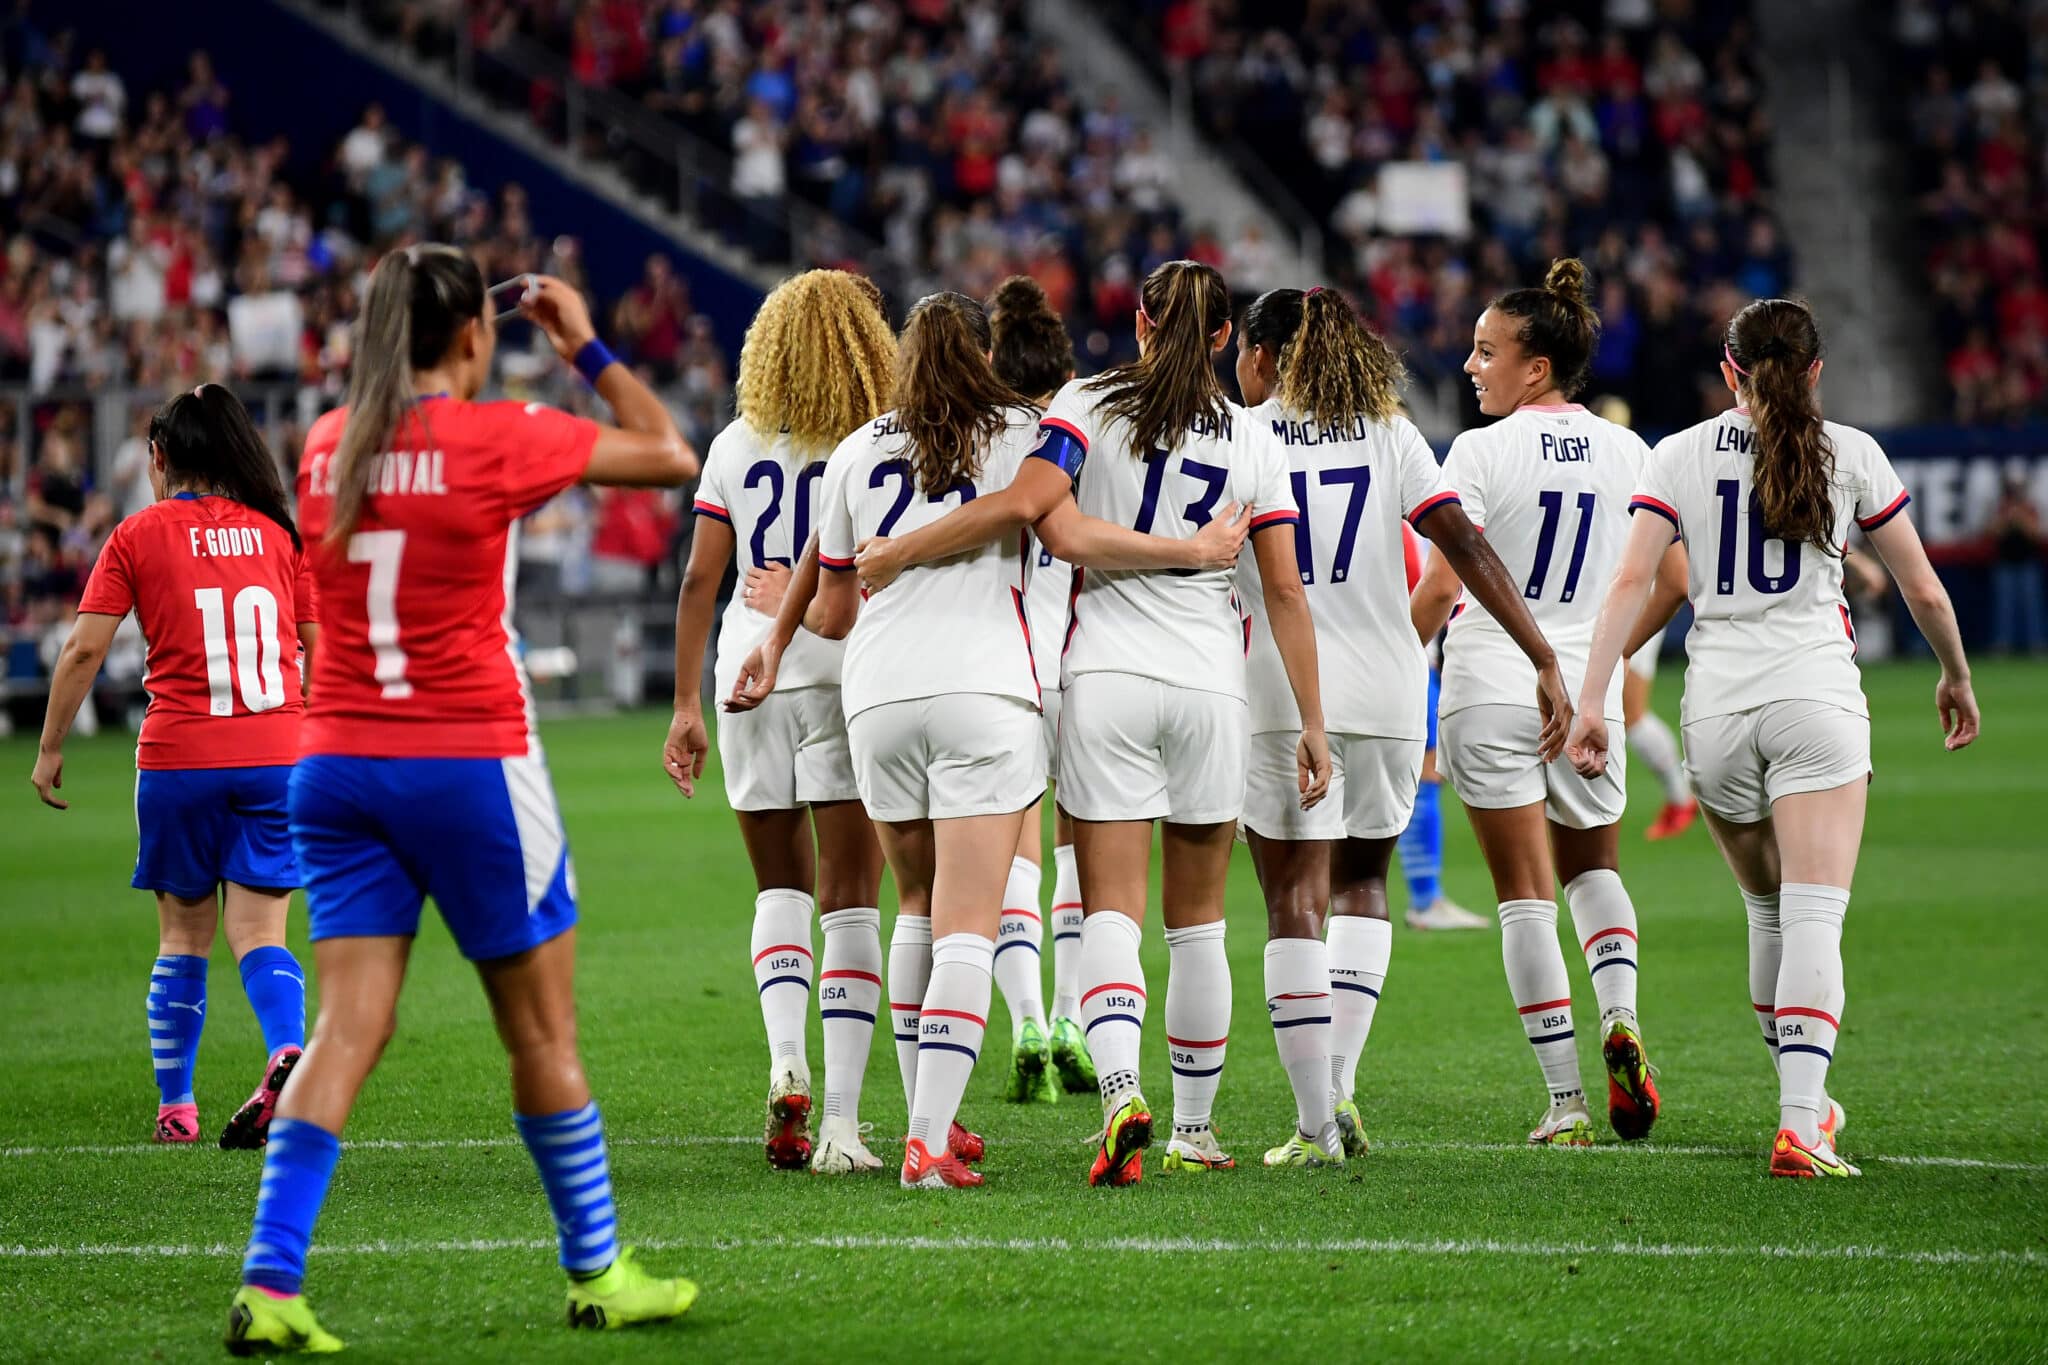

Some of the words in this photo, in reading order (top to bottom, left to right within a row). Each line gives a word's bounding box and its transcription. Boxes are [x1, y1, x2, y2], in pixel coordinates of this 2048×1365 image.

[1272, 415, 1366, 446] MACARO
[1540, 433, 1591, 463] PUGH
[310, 451, 447, 495] F.SDOVAL
[743, 459, 827, 569] 20
[1133, 447, 1229, 577] 13
[1290, 465, 1371, 585] 17
[189, 527, 264, 557] F.GODOY
[1524, 491, 1596, 603] 11
[1716, 479, 1801, 595] 16
[347, 529, 414, 699] 7
[194, 585, 286, 717] 10
[998, 922, 1026, 937] USA
[1596, 941, 1622, 956] USA
[771, 957, 800, 971] USA
[821, 987, 847, 1000] USA
[1106, 996, 1136, 1009] USA
[903, 1017, 920, 1029] US
[922, 1023, 950, 1035] USA
[1542, 1014, 1568, 1029] USA
[1780, 1024, 1803, 1037] USA
[1171, 1050, 1195, 1064] USA
